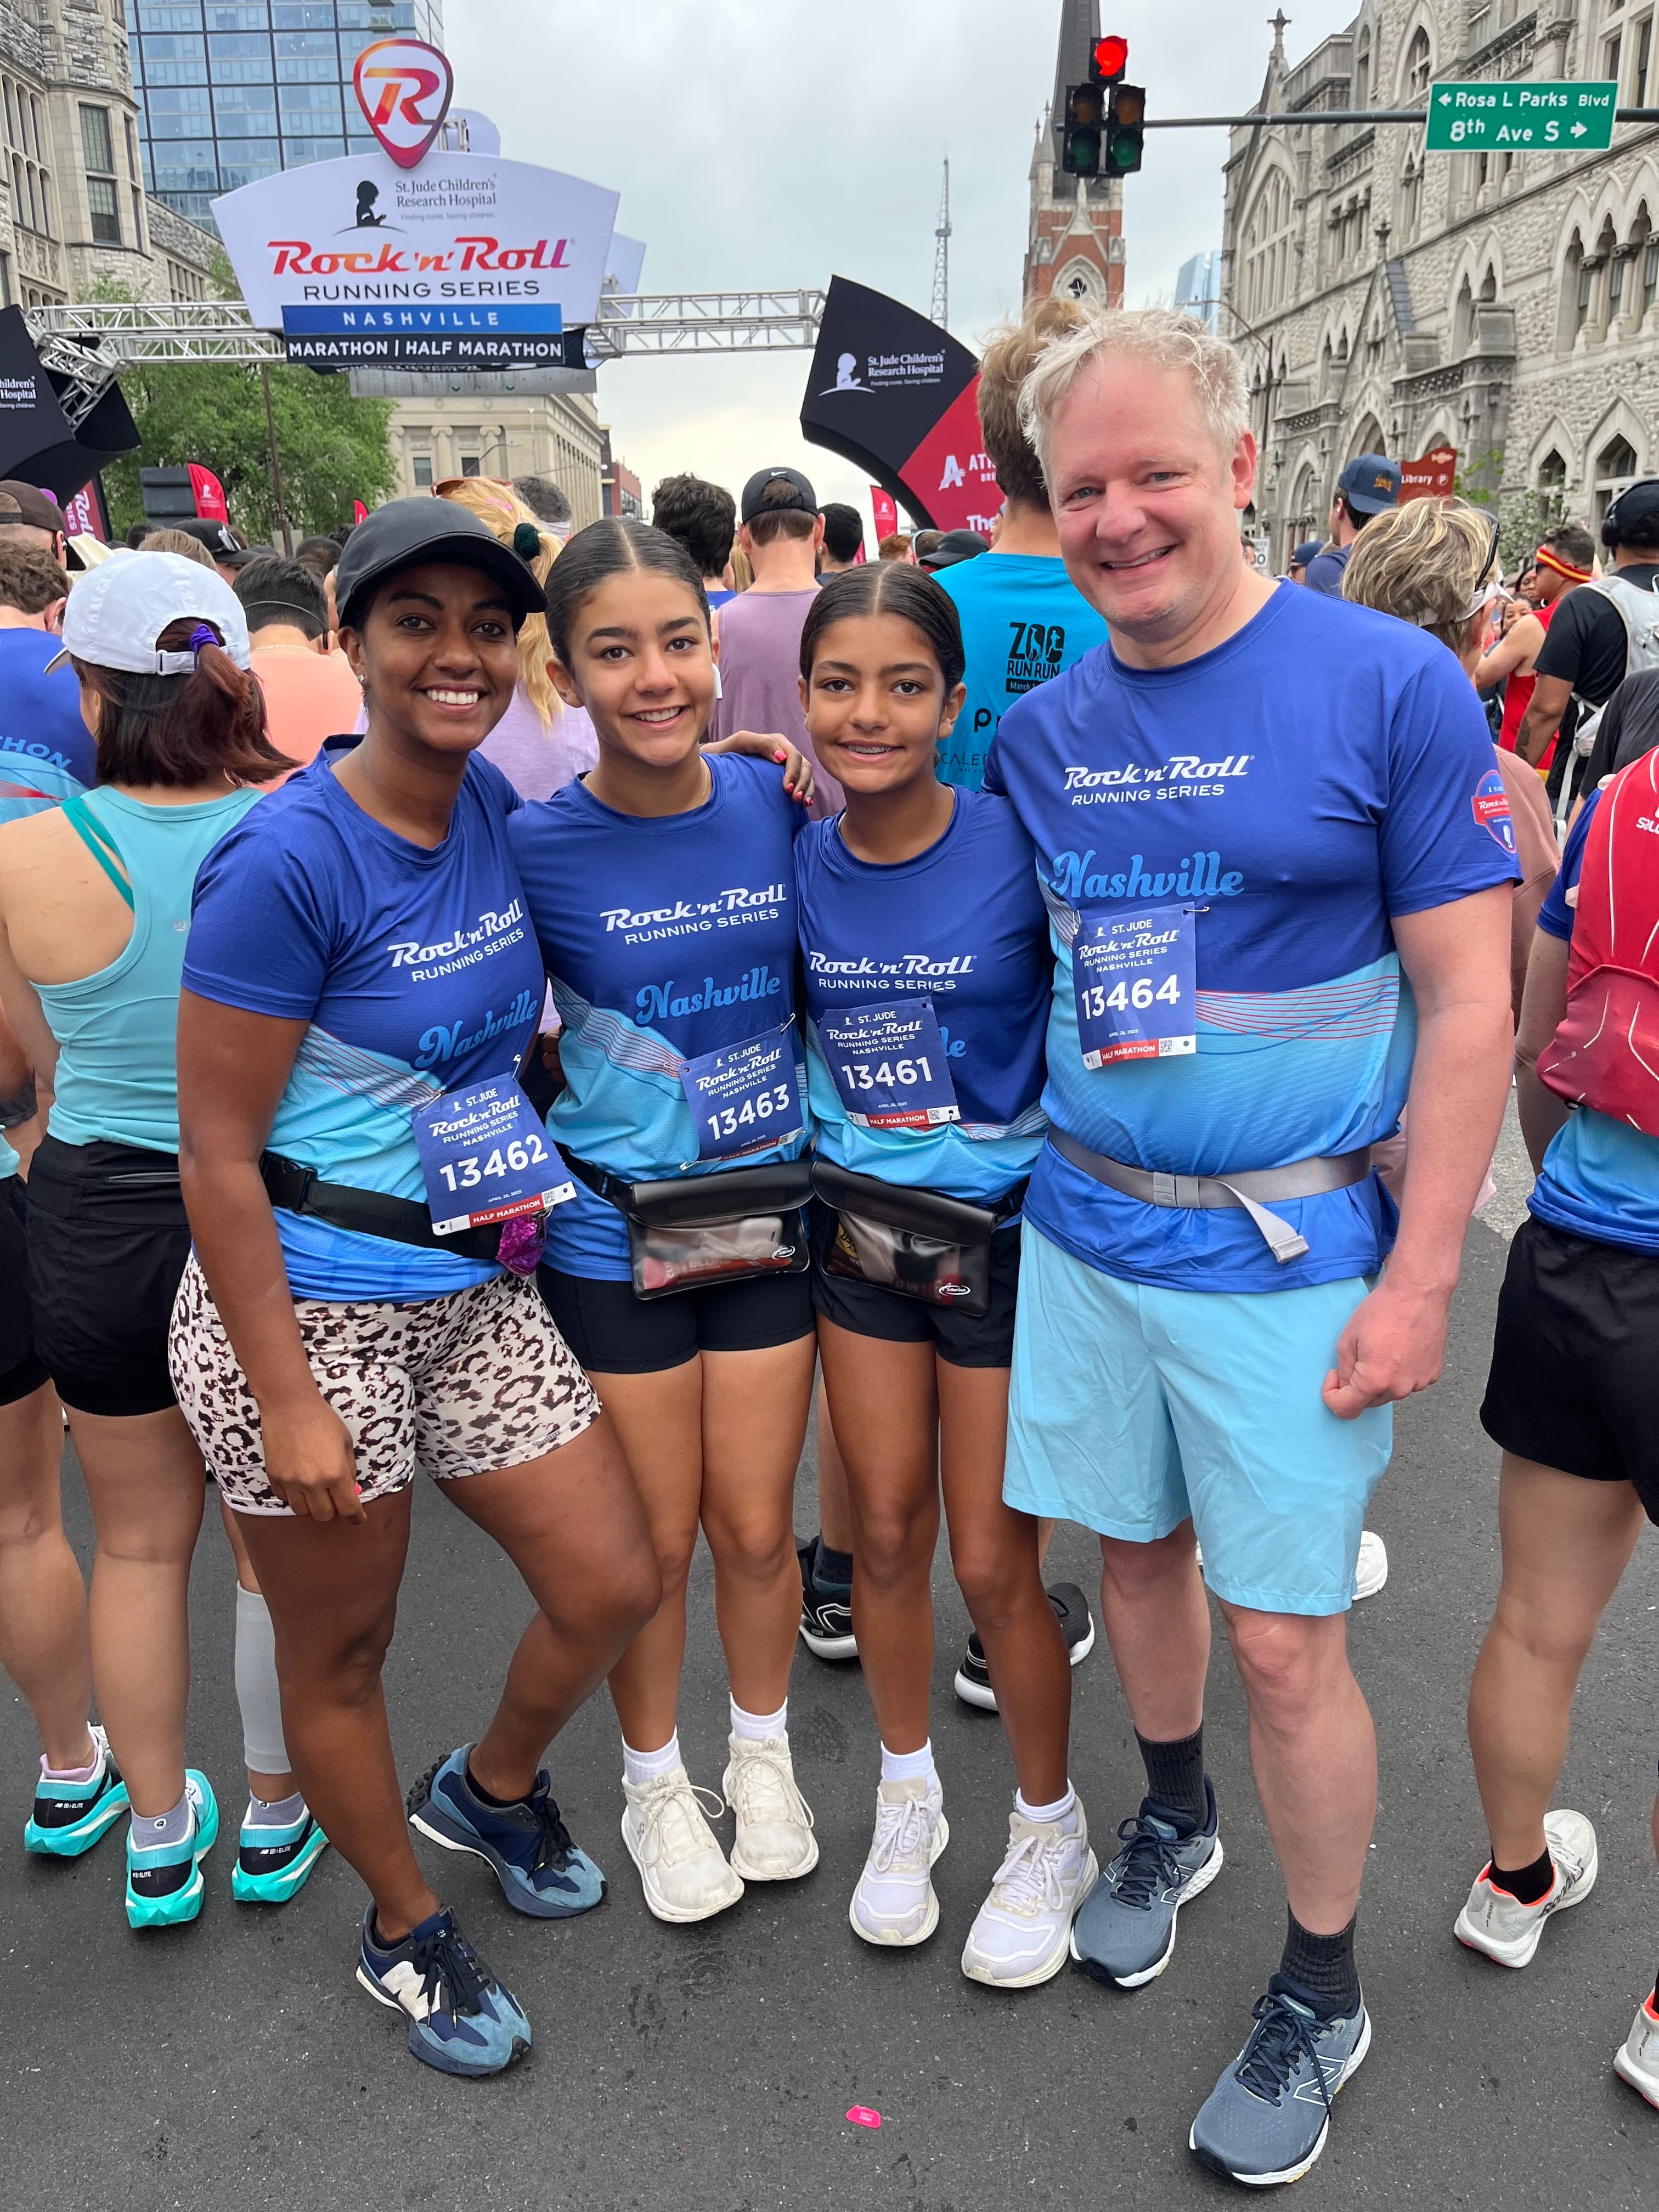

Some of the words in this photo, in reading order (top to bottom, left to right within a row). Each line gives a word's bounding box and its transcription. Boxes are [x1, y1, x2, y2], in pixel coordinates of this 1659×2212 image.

[1455, 92, 1496, 107] Rosa
[1503, 92, 1513, 107] L
[1519, 92, 1567, 107] Parks
[1578, 94, 1609, 106] Blvd
[1450, 119, 1485, 142] 8th
[1496, 125, 1533, 142] Ave
[1544, 121, 1560, 142] S
[396, 180, 410, 193] St.
[412, 180, 436, 194] Jude
[439, 178, 495, 192] Children's
[397, 194, 446, 208] Research
[449, 193, 496, 208] Hospital
[304, 282, 431, 301] RUNNING
[441, 280, 540, 297] SERIES
[343, 312, 499, 326] NASHVILLE
[289, 341, 387, 357] MARATHON
[406, 341, 452, 357] HALF
[459, 341, 562, 358] MARATHON
[868, 356, 879, 366] St.
[880, 354, 900, 368] Jude
[900, 353, 944, 364] Children's
[868, 365, 906, 377] Research
[907, 363, 944, 376] Hospital
[1, 389, 36, 402] Hospital
[1401, 473, 1433, 486] Library
[966, 514, 996, 532] The
[1008, 622, 1065, 664] ZOO
[1007, 660, 1034, 678] RUN
[1034, 662, 1060, 679] RUN
[1010, 681, 1030, 691] March
[0, 736, 72, 769] HON
[1071, 789, 1152, 805] RUNNING
[1155, 784, 1224, 800] SERIES
[1050, 849, 1245, 899] Nashville
[625, 920, 712, 945] RUNNING
[716, 909, 779, 928] SERIES
[1111, 924, 1125, 935] ST.
[1126, 919, 1153, 932] JUDE
[411, 950, 484, 982] RUNNING
[483, 928, 524, 956] SERIES
[1084, 953, 1126, 968] RUNNING
[1128, 946, 1167, 958] SERIES
[1096, 958, 1153, 973] NASHVILLE
[819, 978, 890, 989] RUNNING
[895, 980, 956, 991] SERIES
[636, 966, 781, 1024] Nashville
[1081, 974, 1181, 1020] 13464
[857, 1014, 872, 1024] ST.
[872, 1011, 896, 1022] JUDE
[415, 990, 538, 1069] Nashville
[838, 1039, 879, 1048] RUNNING
[881, 1034, 916, 1043] SERIES
[853, 1043, 905, 1055] NASHVILLE
[728, 1053, 740, 1063] ST.
[740, 1043, 761, 1058] JUDE
[1102, 1051, 1114, 1061] HALF
[1115, 1045, 1155, 1057] MARATHON
[708, 1076, 746, 1096] RUNNING
[747, 1063, 776, 1080] SERIES
[842, 1057, 933, 1090] 13461
[723, 1076, 768, 1099] NASHVILLE
[466, 1098, 478, 1107] ST.
[478, 1088, 498, 1103] JUDE
[707, 1083, 790, 1141] 13463
[886, 1114, 926, 1125] MARATHON
[443, 1122, 489, 1144] RUNNING
[491, 1110, 518, 1127] SERIES
[463, 1123, 514, 1147] NASHVILLE
[741, 1141, 777, 1155] MARATHON
[439, 1134, 549, 1192] 13462
[473, 1213, 495, 1223] HALF
[496, 1199, 540, 1218] MARATHON
